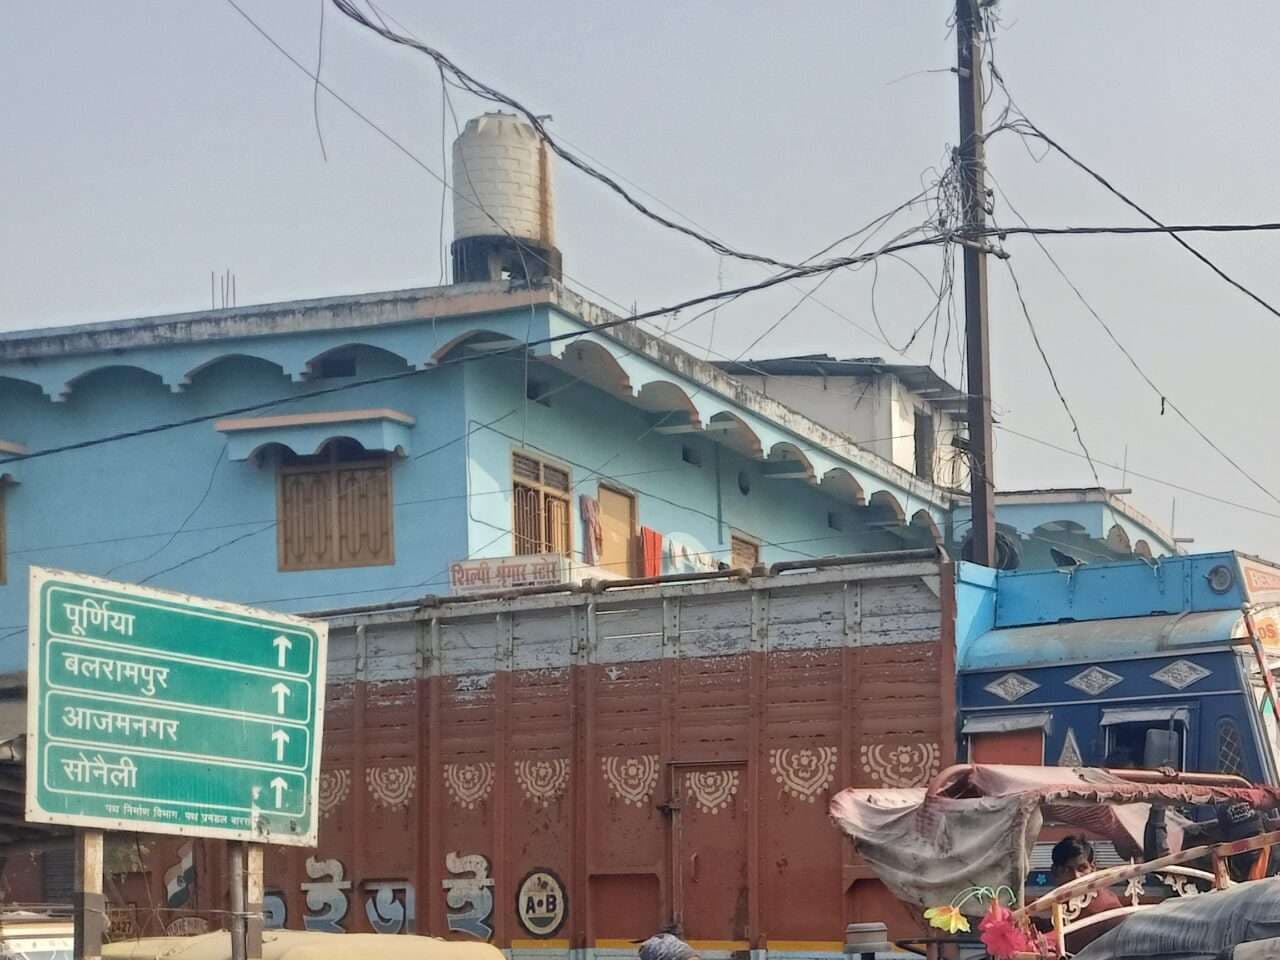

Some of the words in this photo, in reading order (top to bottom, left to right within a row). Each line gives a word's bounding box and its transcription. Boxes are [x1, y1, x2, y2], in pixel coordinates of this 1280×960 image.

[63, 598, 135, 636] पूर्णिया
[62, 652, 170, 695] बलरामपुर
[62, 704, 180, 741] आजमनगर
[61, 752, 138, 788] सोनैली
